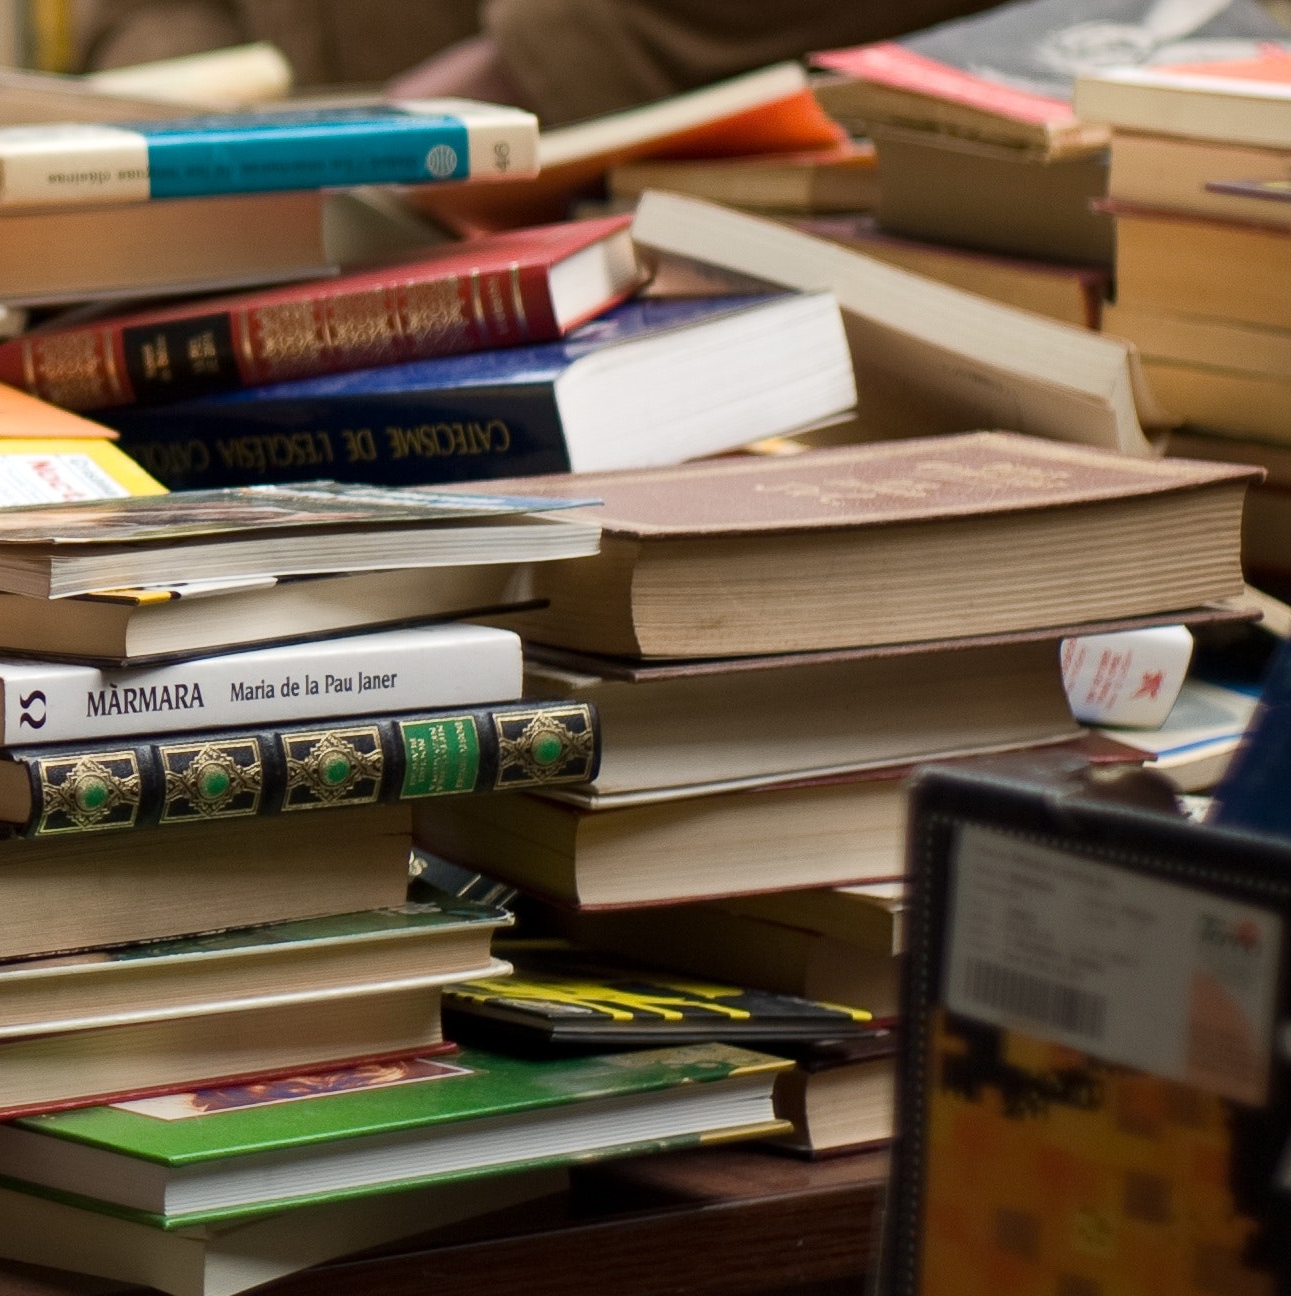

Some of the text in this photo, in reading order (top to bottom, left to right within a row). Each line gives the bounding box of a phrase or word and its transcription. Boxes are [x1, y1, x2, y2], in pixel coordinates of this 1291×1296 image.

[342, 427, 378, 462] DE
[386, 419, 511, 459] CATECISME
[85, 670, 398, 718] MÀRMARA Maria de la Pau Janer
